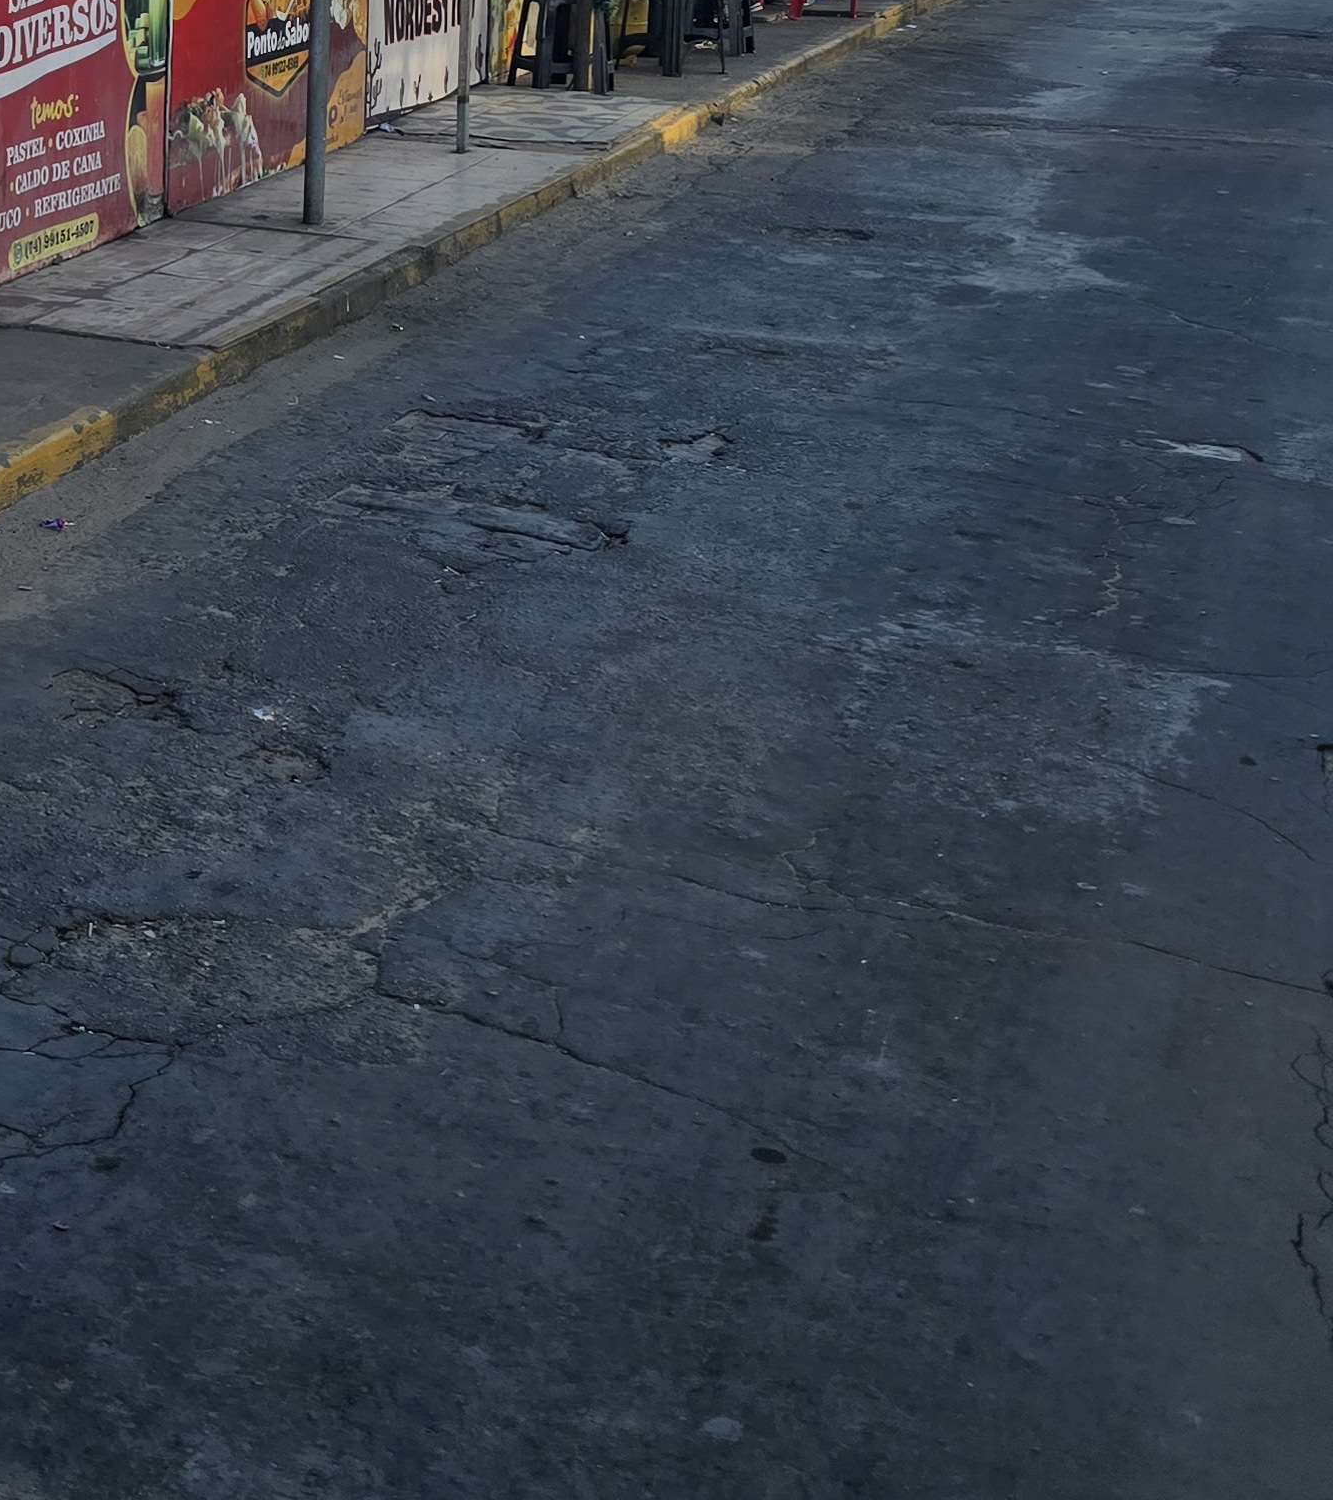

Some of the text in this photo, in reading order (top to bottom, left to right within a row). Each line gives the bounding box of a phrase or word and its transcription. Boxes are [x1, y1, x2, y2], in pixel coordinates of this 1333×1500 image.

[247, 28, 278, 59] Ponto
[285, 16, 310, 48] Sabo
[6, 120, 106, 167] PASTEL COXINHA
[15, 151, 102, 196] CALDO DE CANA
[33, 172, 121, 219] REFRIGERANTE
[43, 219, 95, 251] 99151-4507
